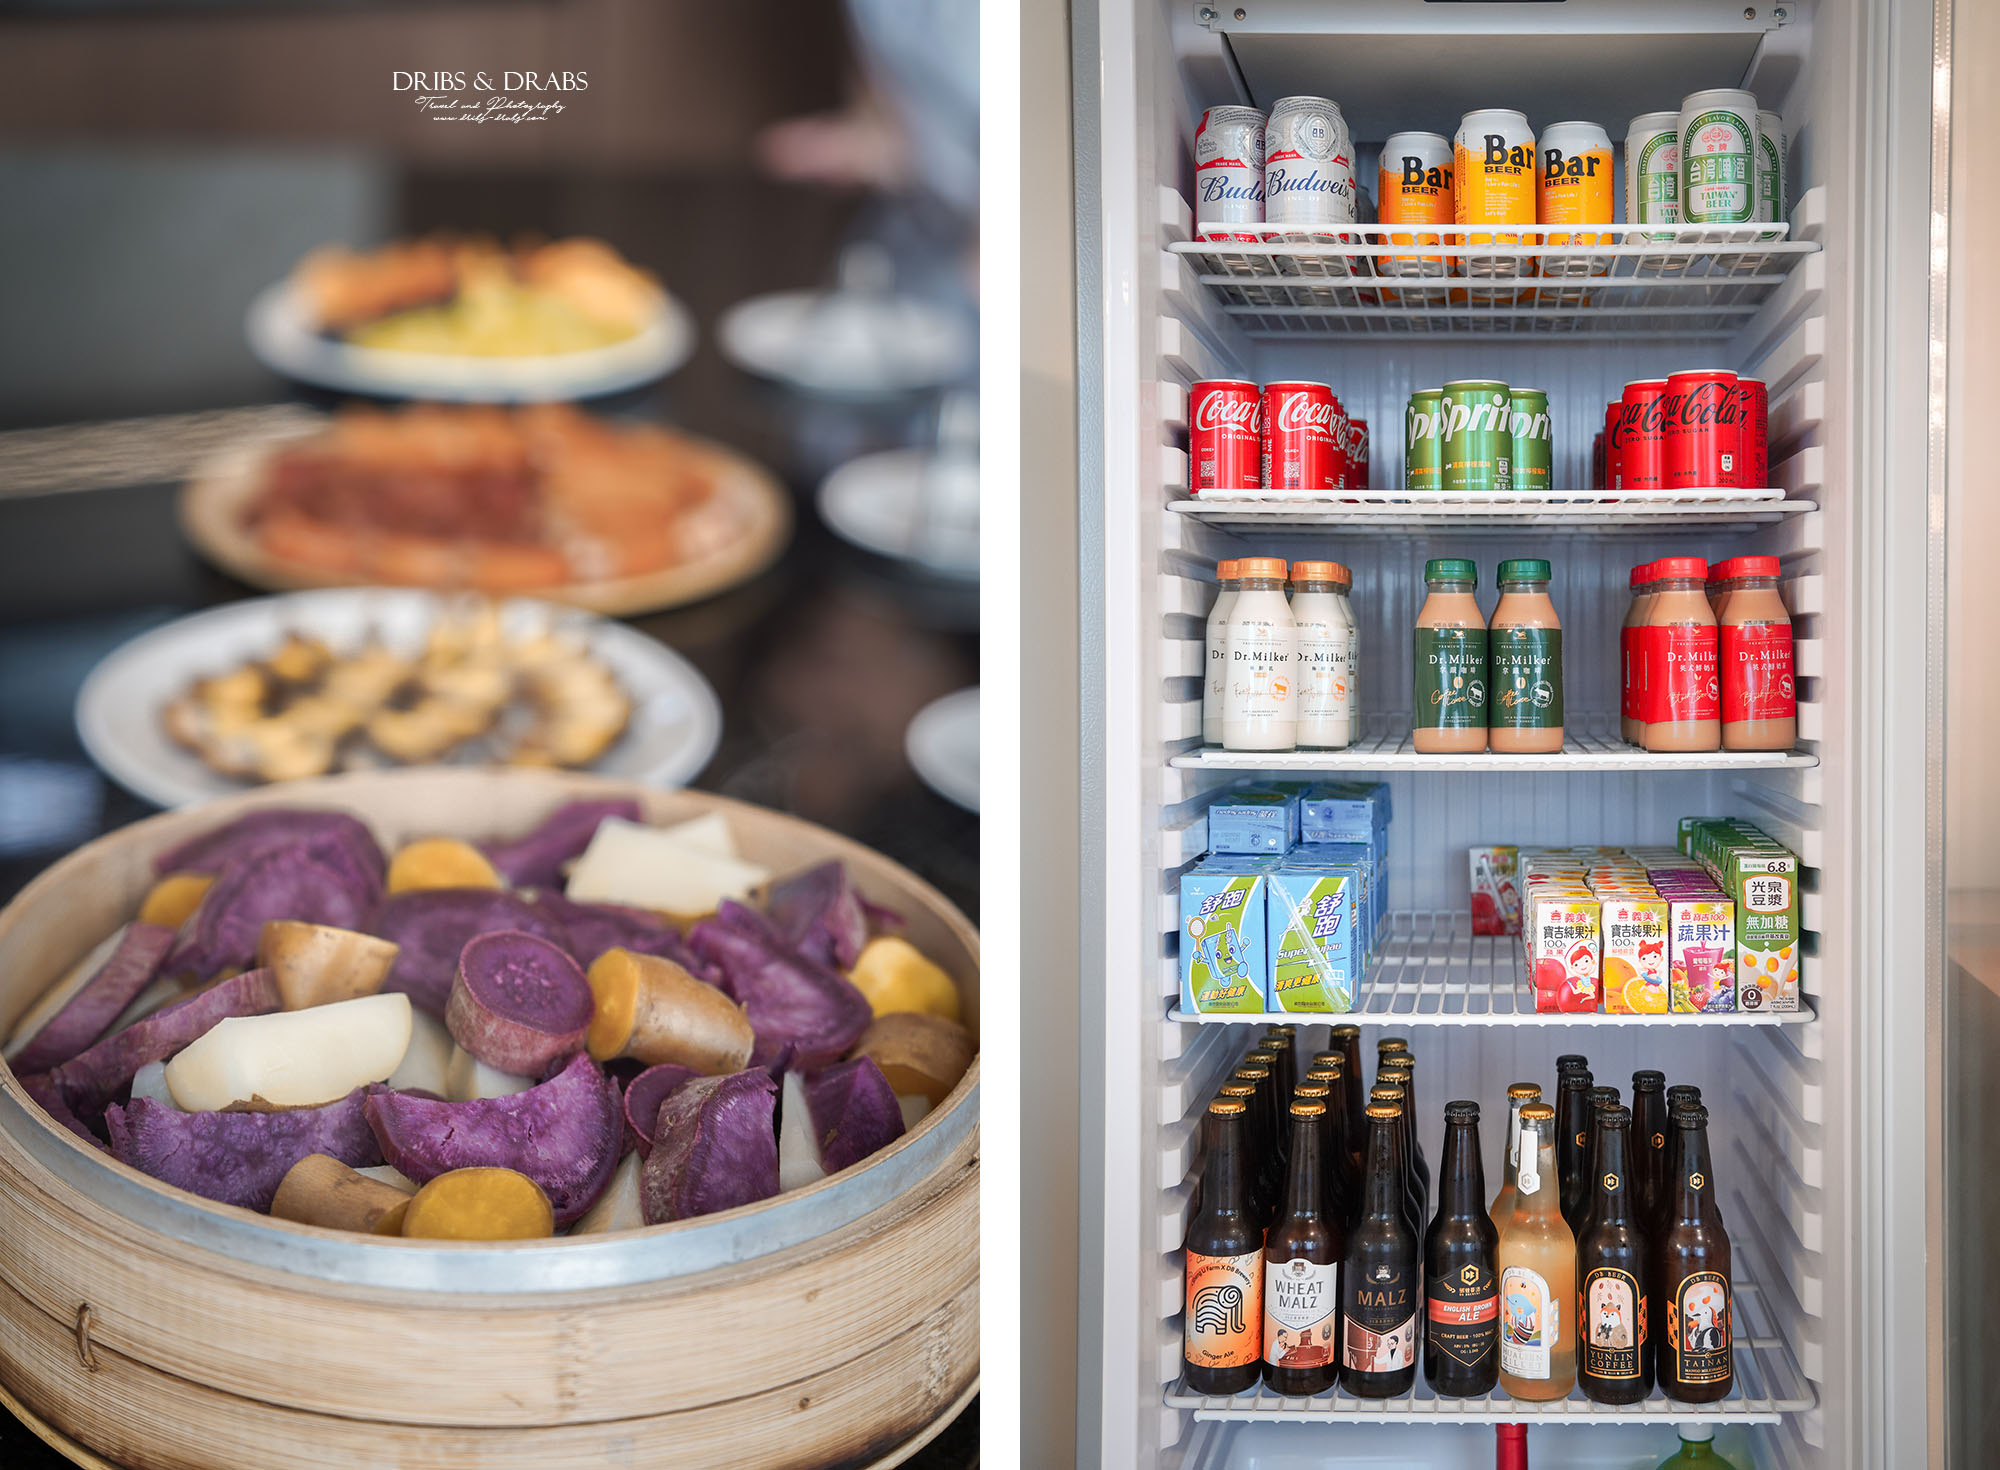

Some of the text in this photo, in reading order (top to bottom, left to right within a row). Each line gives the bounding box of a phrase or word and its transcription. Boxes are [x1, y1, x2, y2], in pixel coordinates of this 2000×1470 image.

[1484, 135, 1534, 169] Bar
[1484, 166, 1522, 175] BEER
[1545, 149, 1601, 180] Bar
[1402, 156, 1453, 190] Bar
[1545, 177, 1580, 187] BEER
[1402, 187, 1438, 195] BEER
[1700, 191, 1736, 201] TAIWAN
[1706, 199, 1731, 209] BEER
[1221, 433, 1256, 442] ORIGINAL
[1234, 651, 1288, 662] Dr.Milker
[1429, 654, 1484, 665] Dr.Milker
[1495, 655, 1552, 665] Dr.Milker
[1767, 861, 1787, 873] 6.8
[1751, 881, 1782, 893] 光泉
[1199, 889, 1247, 915] 舒跑
[1751, 894, 1782, 906] 豆漿
[1312, 892, 1345, 939] 舒跑
[1565, 912, 1587, 924] 義美
[1632, 911, 1654, 922] 義美
[1745, 915, 1789, 930] 無加糖
[1543, 926, 1595, 939] 寶吉純果汁
[1611, 924, 1663, 938] 寶吉純果汁
[1678, 924, 1731, 942] 蔬果汁
[1607, 1271, 1627, 1281] BEER
[1275, 1280, 1324, 1295] WHEAT
[1279, 1295, 1318, 1309] MALZ
[1358, 1289, 1407, 1307] MALZ
[1443, 1304, 1471, 1313] ENGLISH
[1458, 1311, 1480, 1322] ALE
[1202, 1350, 1235, 1360] Ginger Ale
[1590, 1350, 1633, 1361] YUNLIN
[1590, 1358, 1633, 1369] COFFEE
[1684, 1355, 1728, 1368] TAINAN
